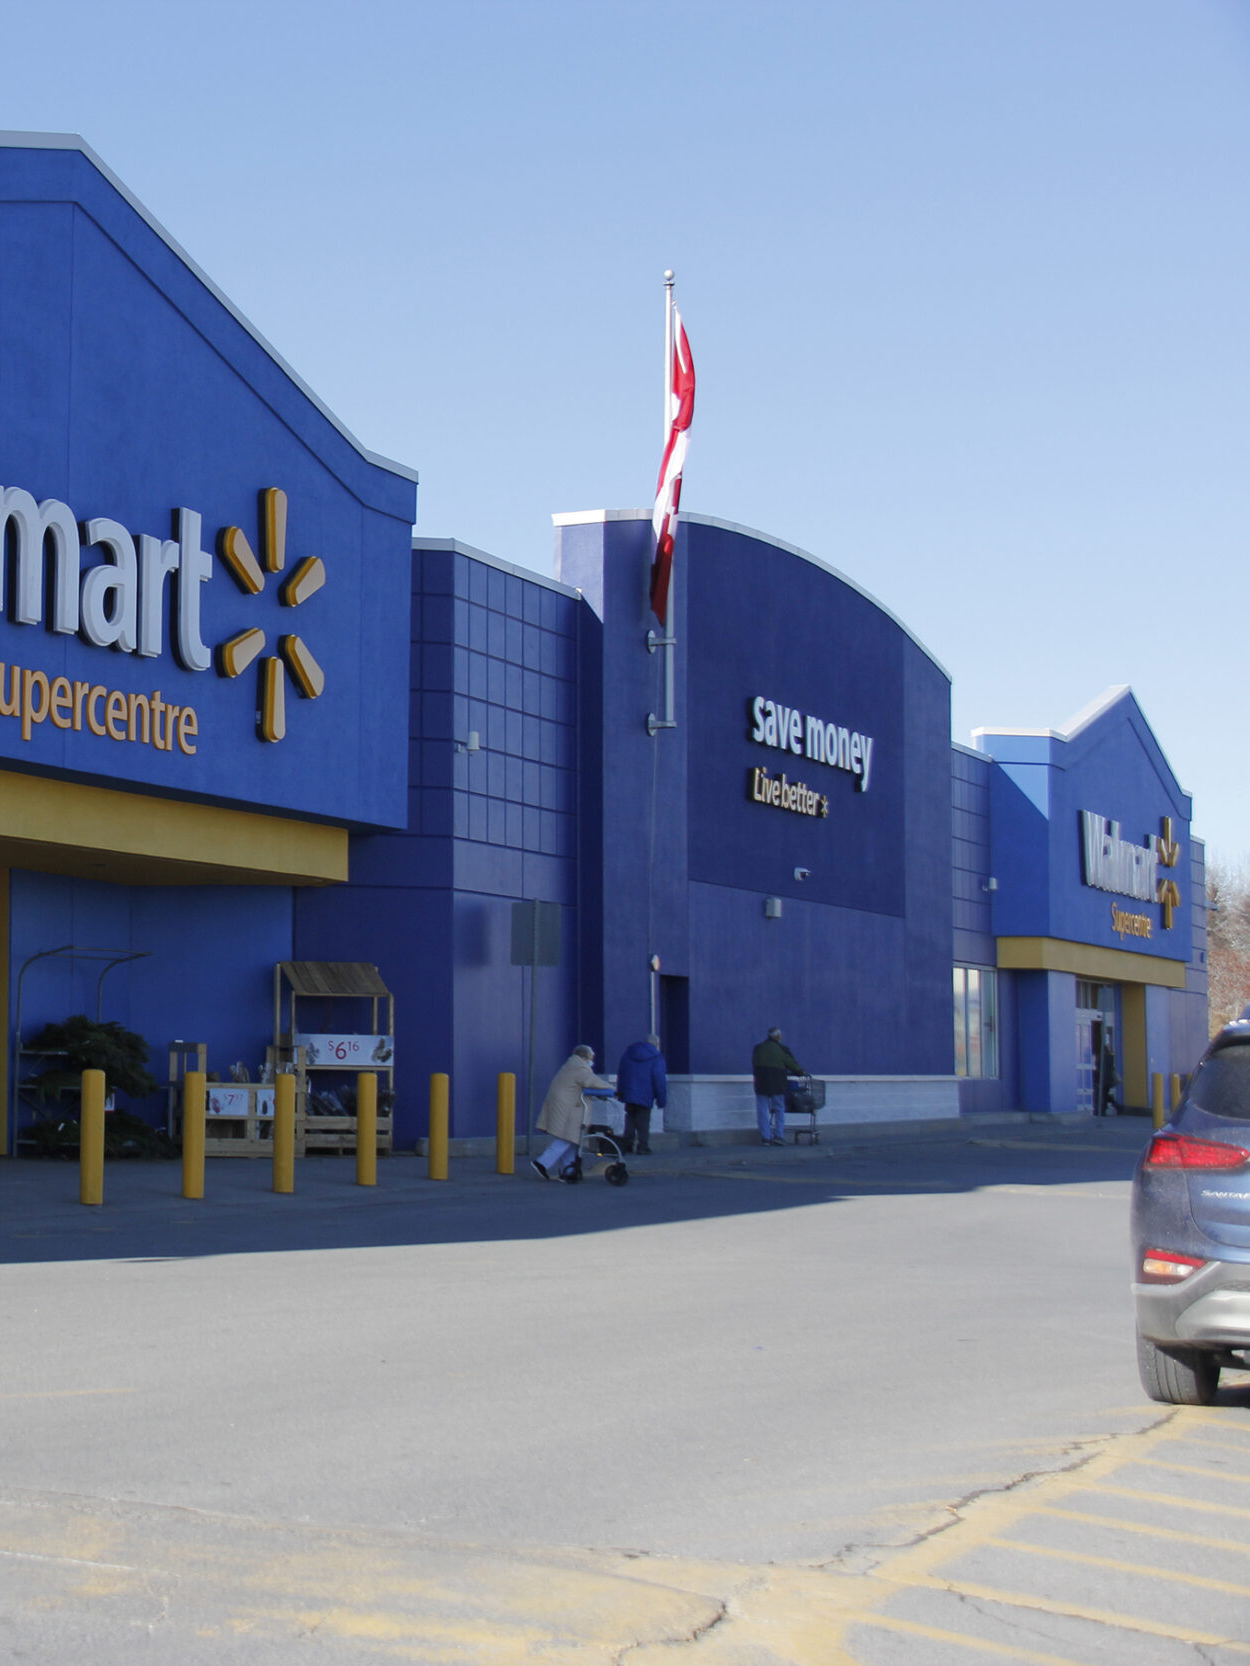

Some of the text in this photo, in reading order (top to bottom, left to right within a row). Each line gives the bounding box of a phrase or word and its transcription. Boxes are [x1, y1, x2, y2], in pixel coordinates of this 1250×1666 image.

[753, 695, 873, 792] save money
[753, 766, 820, 816] Live better
[1080, 809, 1158, 904] Walmart
[1111, 901, 1152, 940] Supercentre
